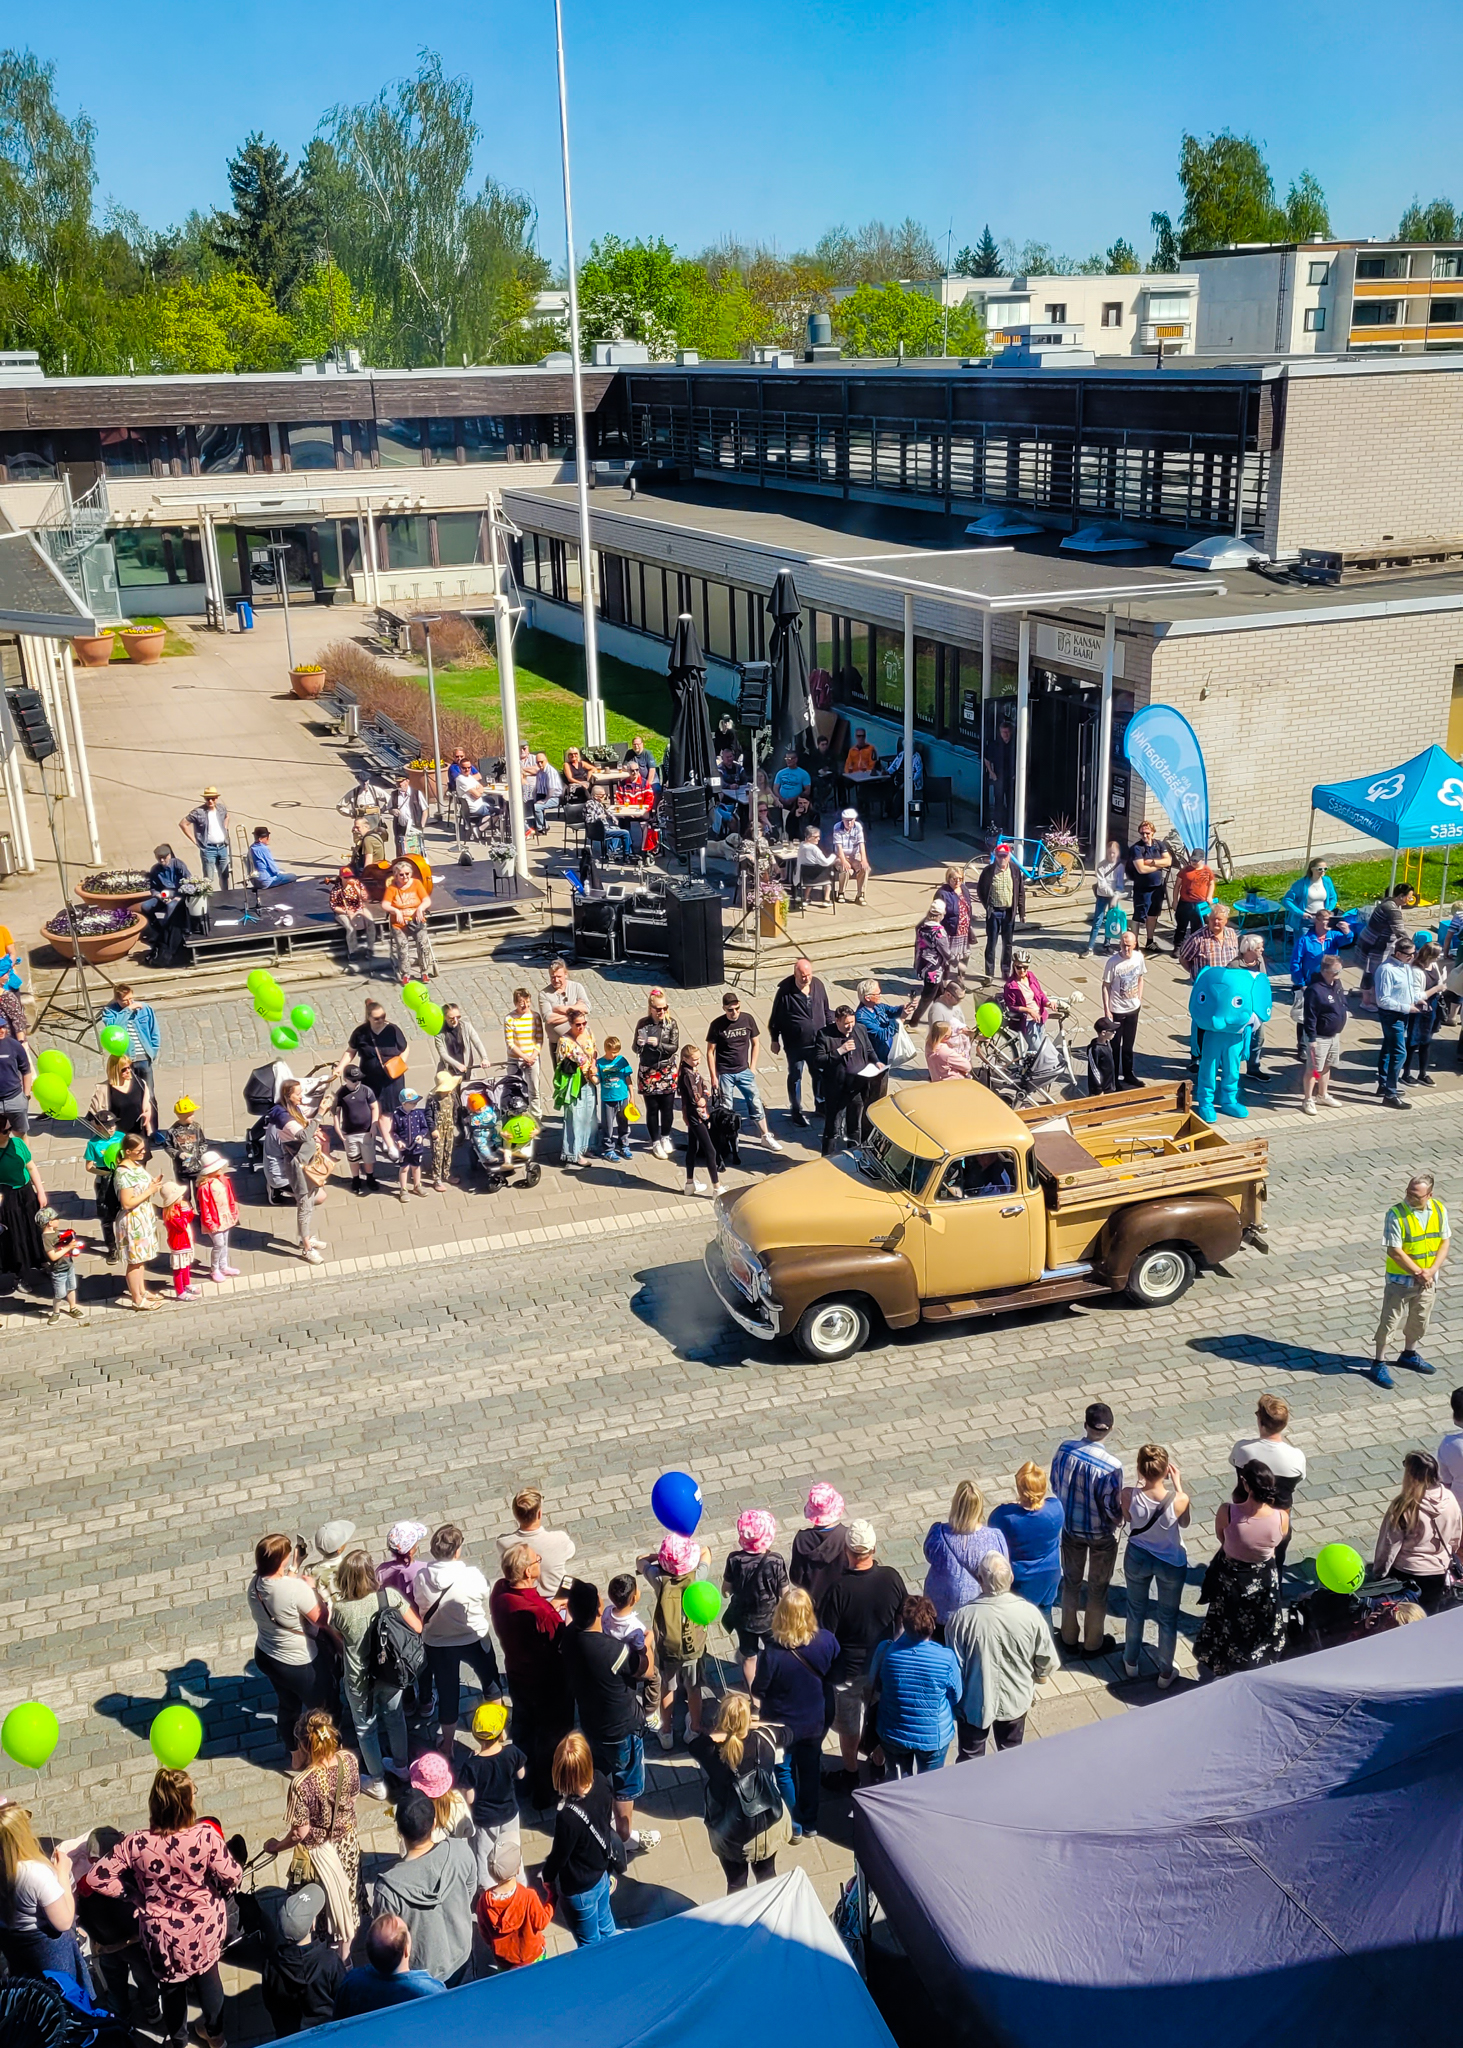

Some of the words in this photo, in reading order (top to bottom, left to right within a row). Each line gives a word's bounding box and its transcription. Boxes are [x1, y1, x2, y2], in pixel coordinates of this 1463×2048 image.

[1073, 635, 1101, 650] KANSAN
[1073, 646, 1094, 660] BAARI
[1328, 797, 1384, 833] Säästöpankki
[723, 1027, 747, 1039] VANS
